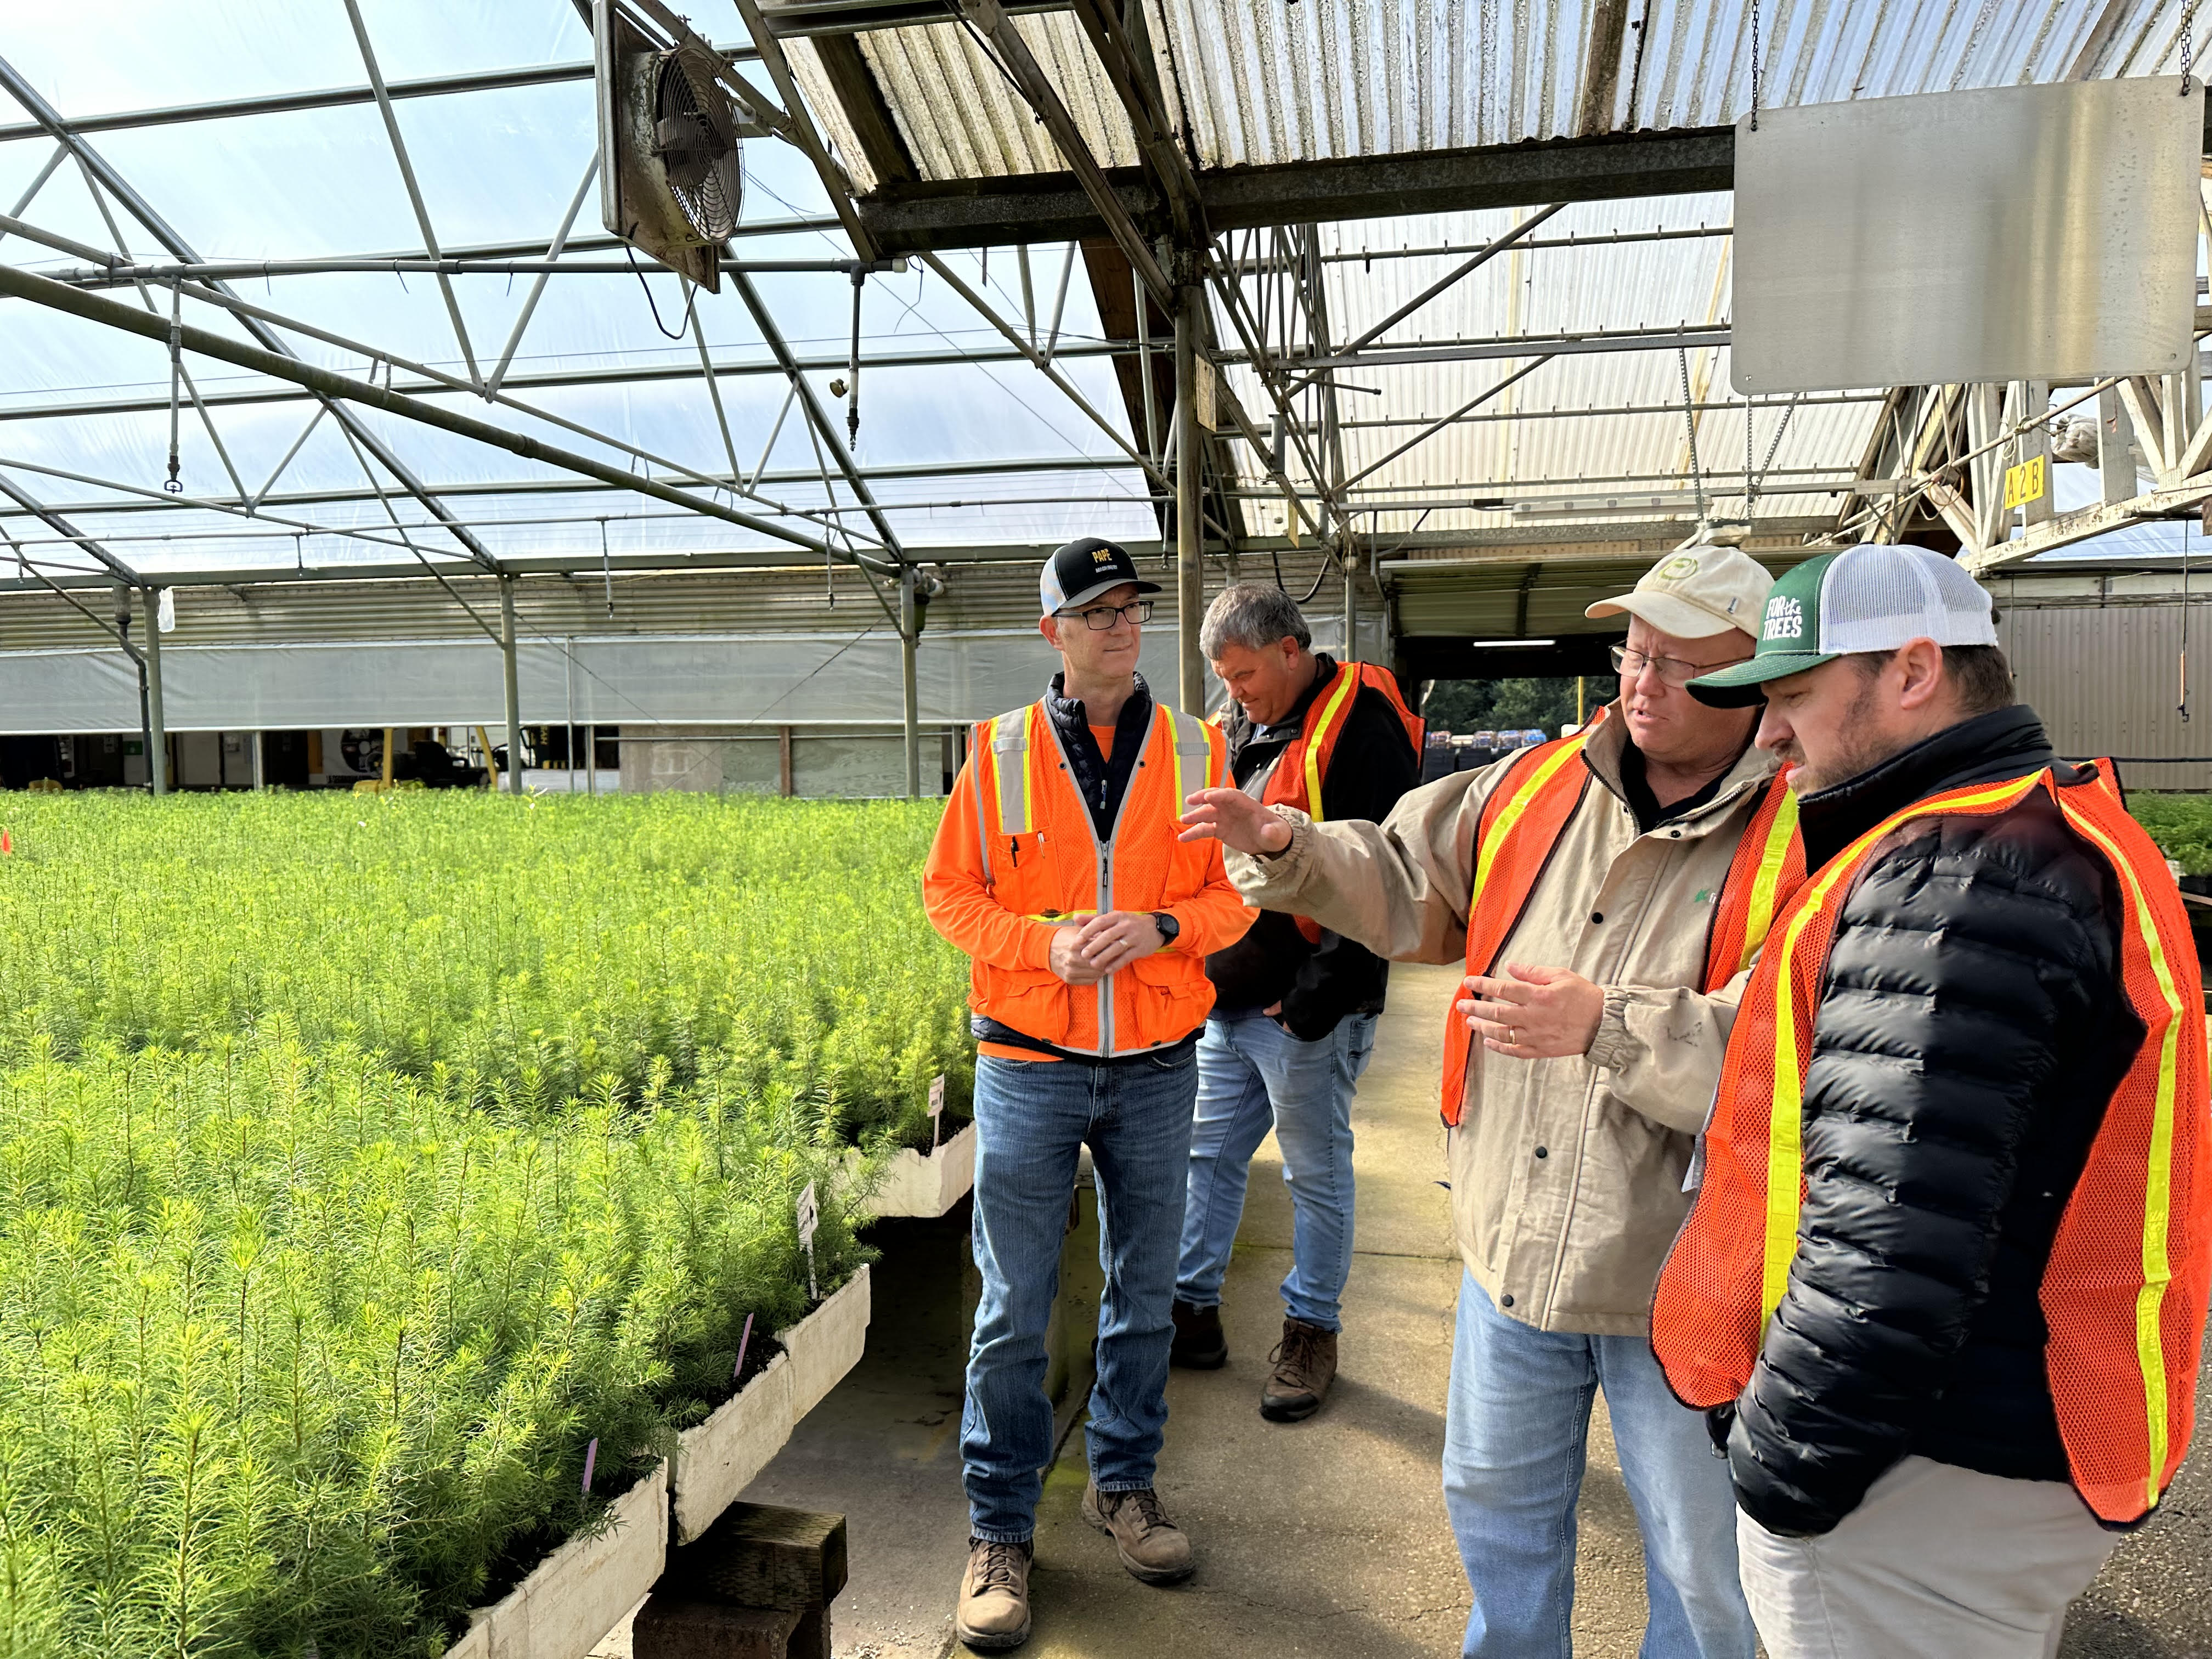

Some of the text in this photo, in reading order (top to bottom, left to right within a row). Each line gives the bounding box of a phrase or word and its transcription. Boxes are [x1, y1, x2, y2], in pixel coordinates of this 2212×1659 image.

[1765, 595, 1802, 619] FOR the
[1762, 615, 1803, 641] TREES
